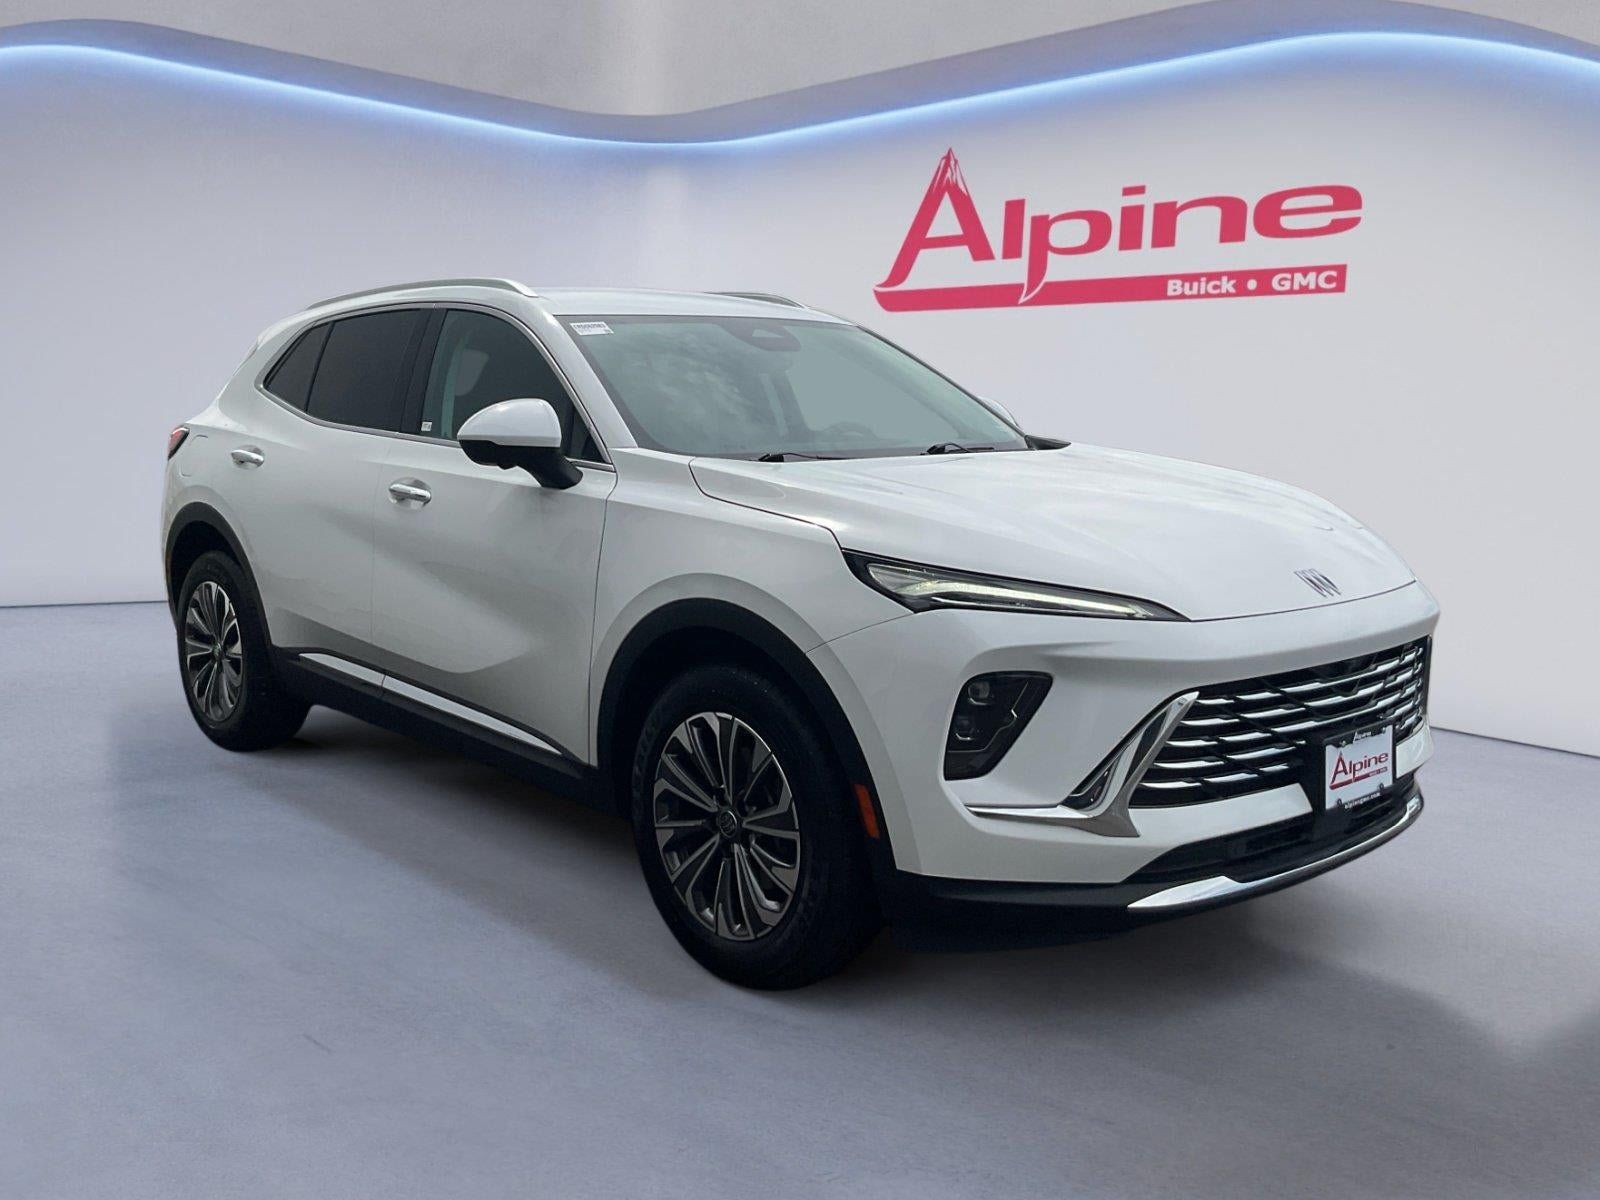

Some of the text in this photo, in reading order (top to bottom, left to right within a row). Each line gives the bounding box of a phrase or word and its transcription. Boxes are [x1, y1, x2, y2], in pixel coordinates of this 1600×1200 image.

[874, 147, 1363, 304] Alpine
[1166, 271, 1338, 296] Buick GMC
[1330, 751, 1389, 785] Alpine
